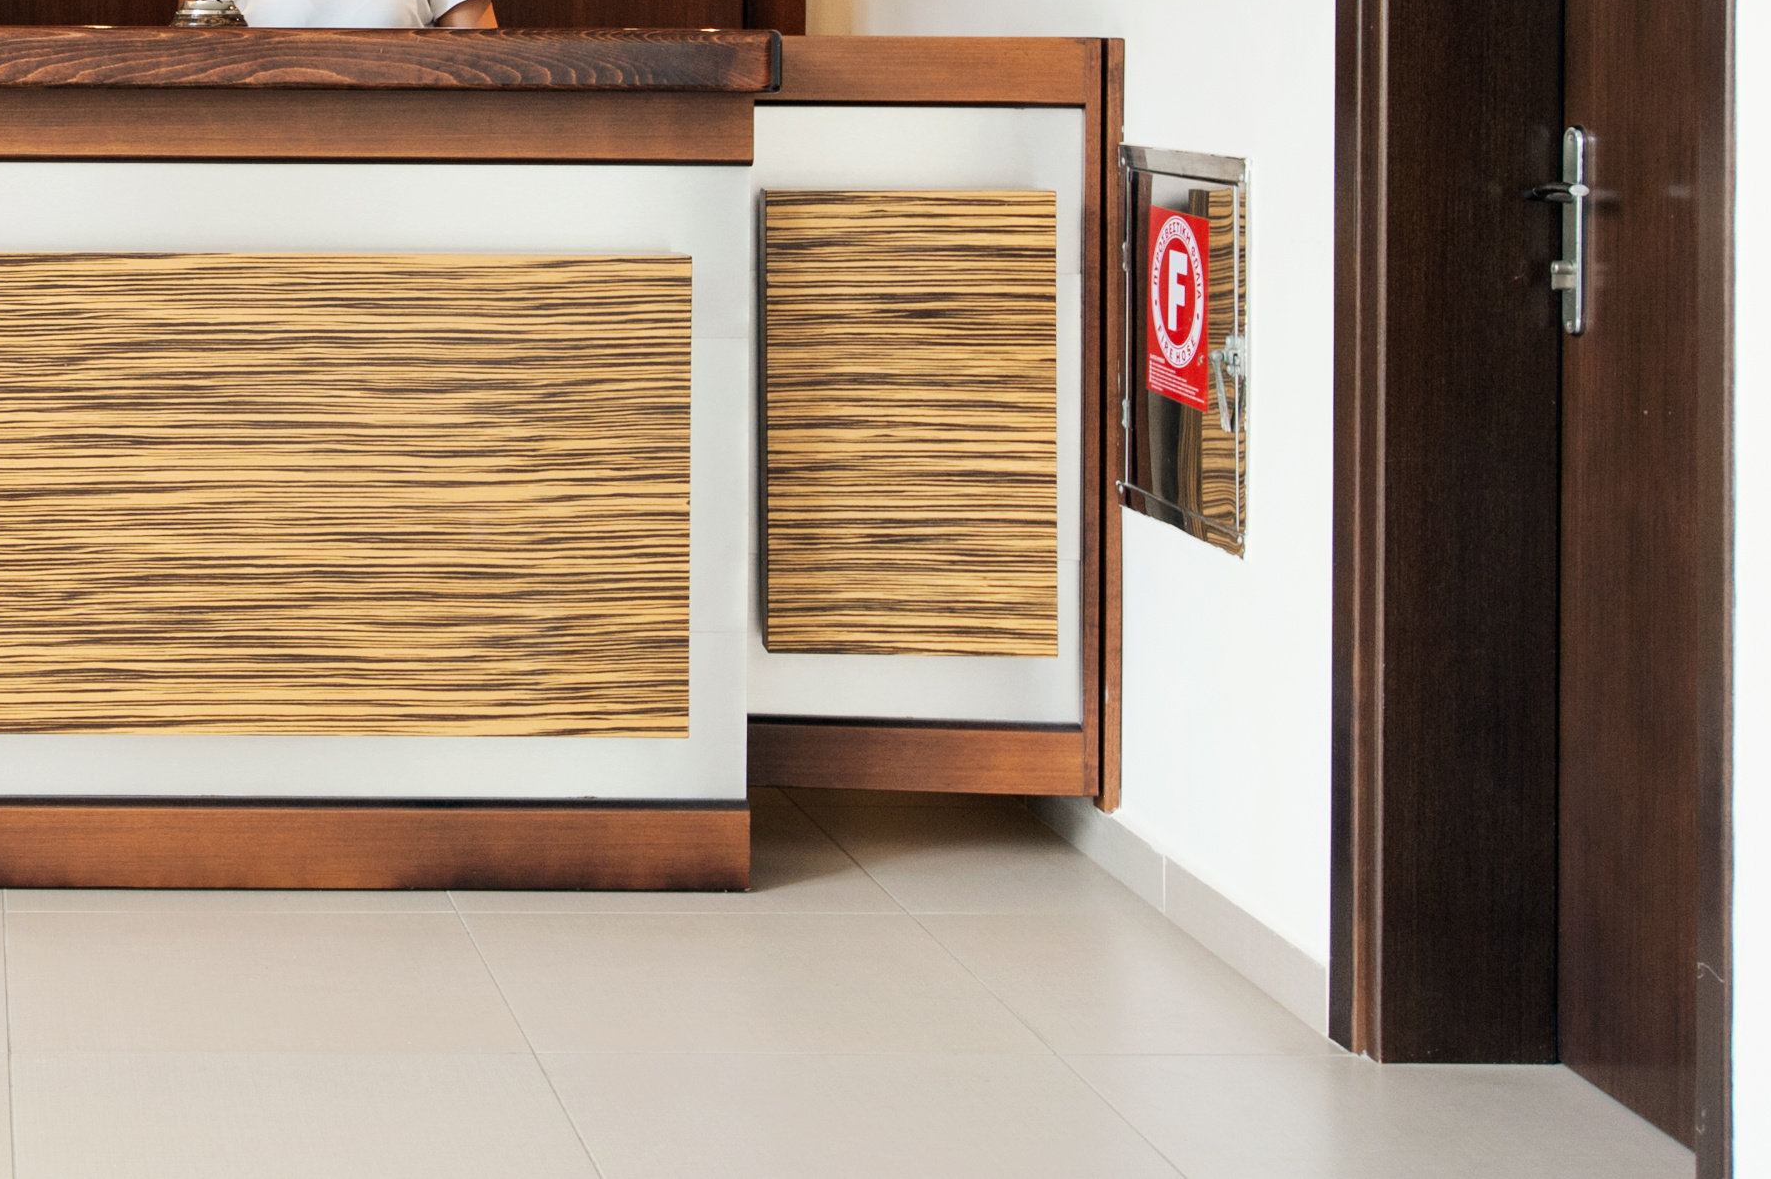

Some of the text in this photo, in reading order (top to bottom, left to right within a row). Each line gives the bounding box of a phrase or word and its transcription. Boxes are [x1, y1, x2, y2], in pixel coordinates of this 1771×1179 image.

[1167, 249, 1189, 332] F
[1157, 324, 1196, 363] FIRE HOSE
